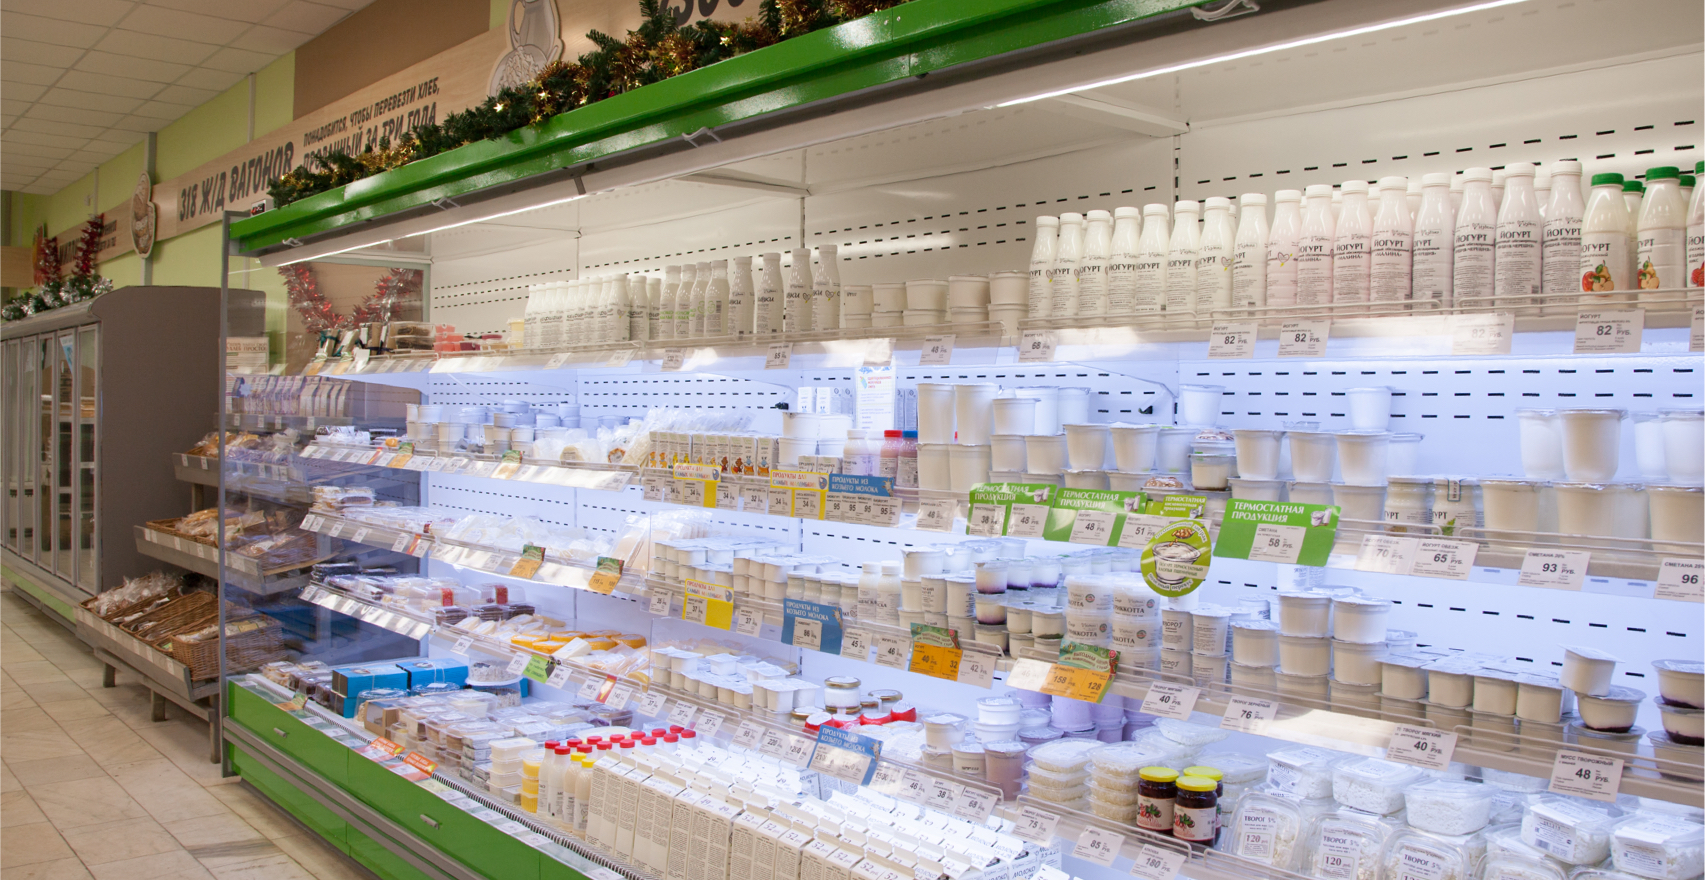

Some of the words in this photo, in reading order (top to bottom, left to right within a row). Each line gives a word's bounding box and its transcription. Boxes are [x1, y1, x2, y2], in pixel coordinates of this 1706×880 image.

[303, 116, 348, 148] ПОНАДОБИТСЯ,
[350, 108, 372, 127] ЧТОБЫ
[373, 91, 416, 118] ПЕРЕВЕЗТИ
[417, 76, 440, 98] ХЛЕБ,
[365, 127, 378, 149] ЗА
[382, 115, 403, 141] ТРИ
[180, 184, 198, 221] 318
[199, 171, 226, 214] Ж/Д
[229, 141, 294, 203] ВАГОНОВ
[1456, 234, 1488, 242] ЙОГУРТ
[1500, 231, 1531, 239] ЙОГУРТ
[1546, 228, 1581, 238] ЙОГУРТ
[1472, 329, 1485, 338] 82
[1596, 325, 1612, 336] 82
[1224, 336, 1235, 344] 82
[1294, 333, 1307, 342] 82
[931, 346, 939, 354] 48
[1032, 342, 1041, 350] 68
[832, 483, 857, 492] КОЗЬЕГО
[858, 485, 878, 493] МОЛОКА
[974, 492, 1016, 501] ПРОДУКЦИЯ
[1063, 490, 1119, 501] ТЕРМОСТАТНАЯ
[1060, 499, 1106, 509] ПРОДУКЦИЯ
[1234, 502, 1305, 514] ТЕРМОСТАТНАЯ
[981, 516, 989, 524] 38
[1020, 516, 1029, 524] 48
[1232, 512, 1288, 523] ПРОДУКЦИЯ
[1085, 522, 1095, 531] 48
[1135, 527, 1145, 535] 51
[1269, 537, 1280, 547] 58
[1376, 548, 1390, 558] 70
[1433, 553, 1448, 563] 65
[1542, 562, 1557, 573] 93
[1682, 574, 1698, 584] 96
[687, 581, 707, 591] ПРОДУКТЫ
[1172, 580, 1193, 591] перекус
[786, 601, 810, 611] ПРОДУКТЫ
[786, 609, 806, 618] КОЗЬЕГО
[807, 612, 829, 621] МОЛОКА
[1073, 652, 1096, 661] ВЫГОДНАЯ
[1054, 676, 1067, 684] 158
[1088, 682, 1102, 691] 128
[1159, 695, 1170, 703] 40
[1241, 710, 1252, 719] 76
[822, 727, 849, 741] ПРОДУКТЫ
[821, 735, 842, 746] КОЗЬЕГО
[843, 742, 865, 752] МОЛОКА
[1414, 741, 1427, 751] 40
[1577, 756, 1613, 766] ТВОРОЖНЫЙ
[1576, 768, 1591, 779] 48
[968, 800, 978, 808] 68
[1028, 820, 1038, 829] 75
[786, 832, 798, 840] 52
[1246, 835, 1260, 843] 120
[1323, 835, 1348, 844] ТВОРОГ
[1090, 840, 1101, 849] 85
[834, 852, 848, 860] 52
[1325, 856, 1342, 866] 120
[1404, 854, 1429, 866] ТВОРОГ
[860, 862, 874, 872] 52
[943, 861, 955, 870] 52
[1146, 857, 1161, 868] 180
[1012, 866, 1036, 879] МОЛОКО
